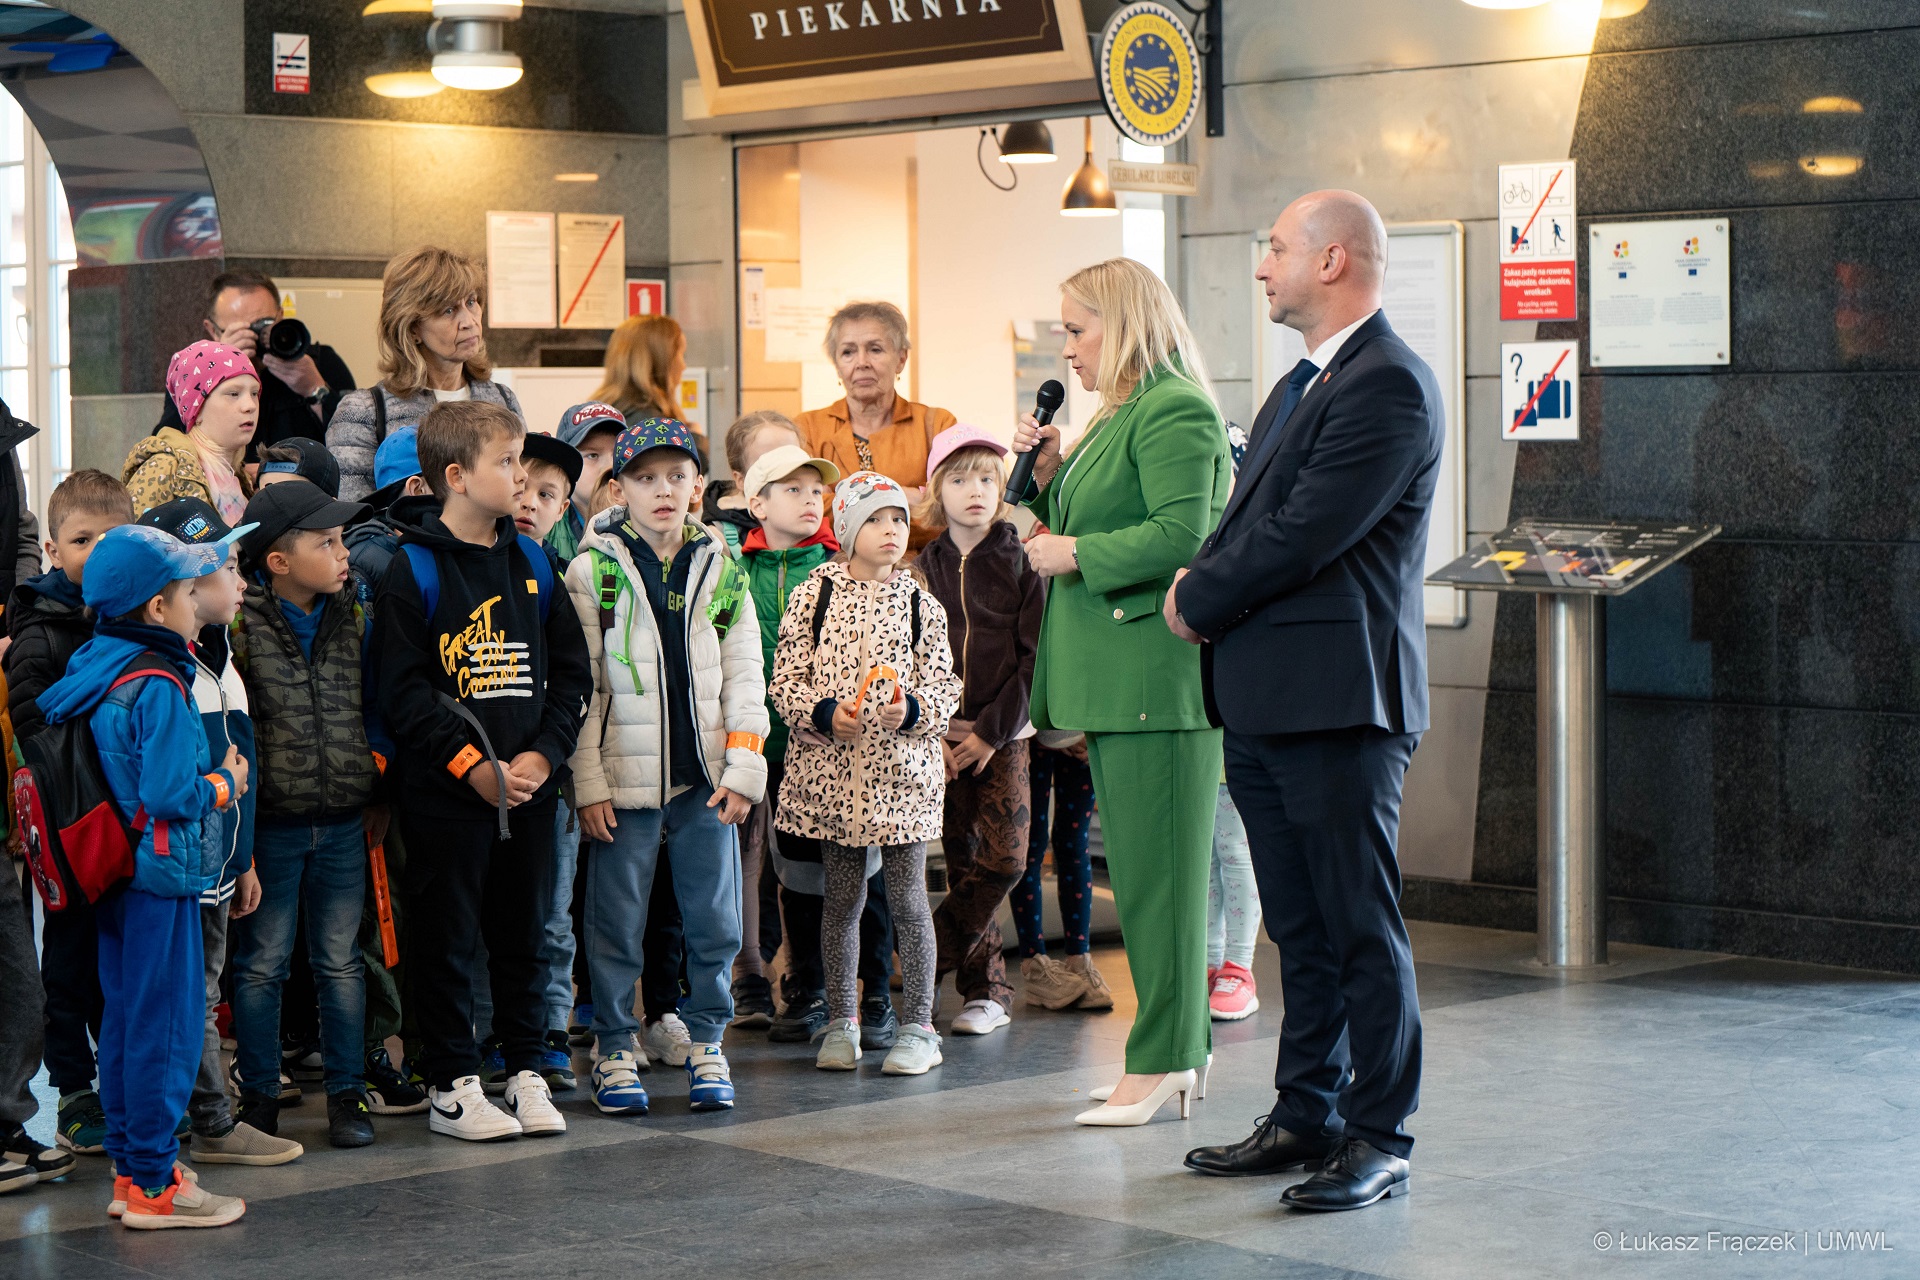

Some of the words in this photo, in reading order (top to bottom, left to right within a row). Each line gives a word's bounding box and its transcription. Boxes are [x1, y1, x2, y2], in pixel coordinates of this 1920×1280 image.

[1111, 166, 1155, 183] CEBULARZ
[1157, 169, 1195, 187] LUBELSKI
[1504, 268, 1520, 276] Zakaz
[1521, 268, 1537, 277] jazdy
[1524, 287, 1552, 296] wrotkach
[439, 595, 502, 676] GREAT
[473, 630, 505, 674] DAY
